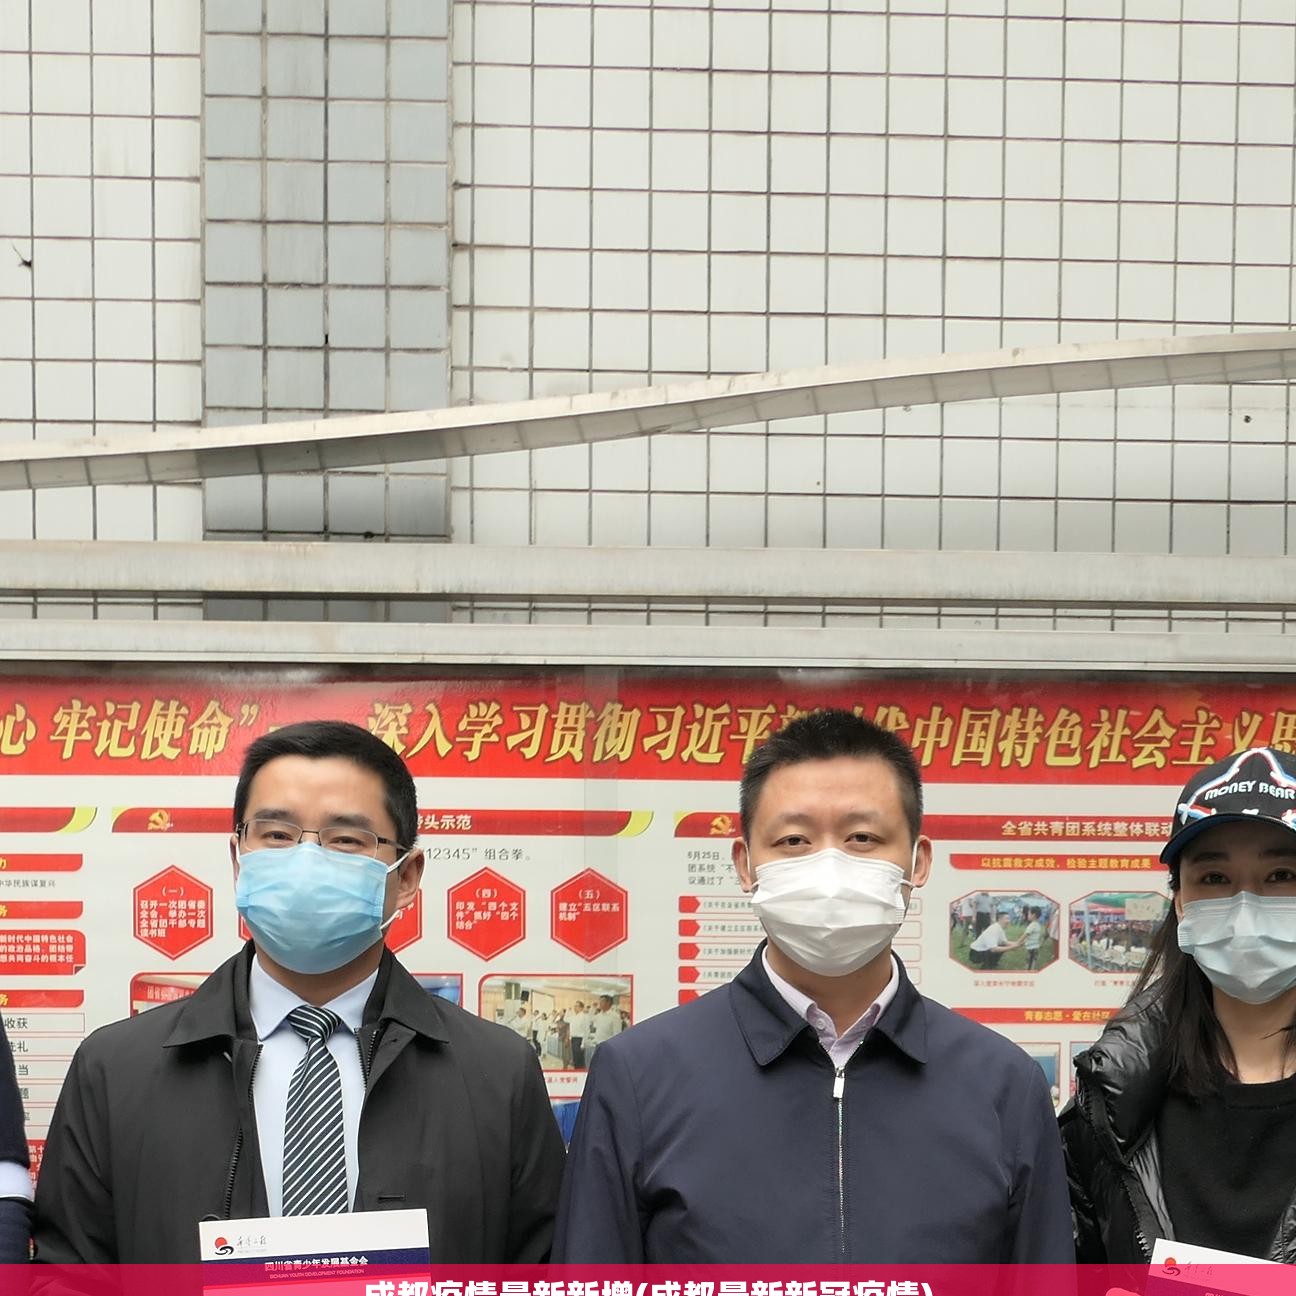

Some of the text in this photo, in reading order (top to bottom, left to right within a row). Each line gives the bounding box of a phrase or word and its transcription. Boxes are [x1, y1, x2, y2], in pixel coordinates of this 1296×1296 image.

[1205, 780, 1296, 801] MONEY BEAR
[1001, 820, 1173, 837] 全省共青团系统整体联动
[4, 1017, 29, 1029] 收获
[264, 1256, 369, 1272] 四川省青少年发展基金会
